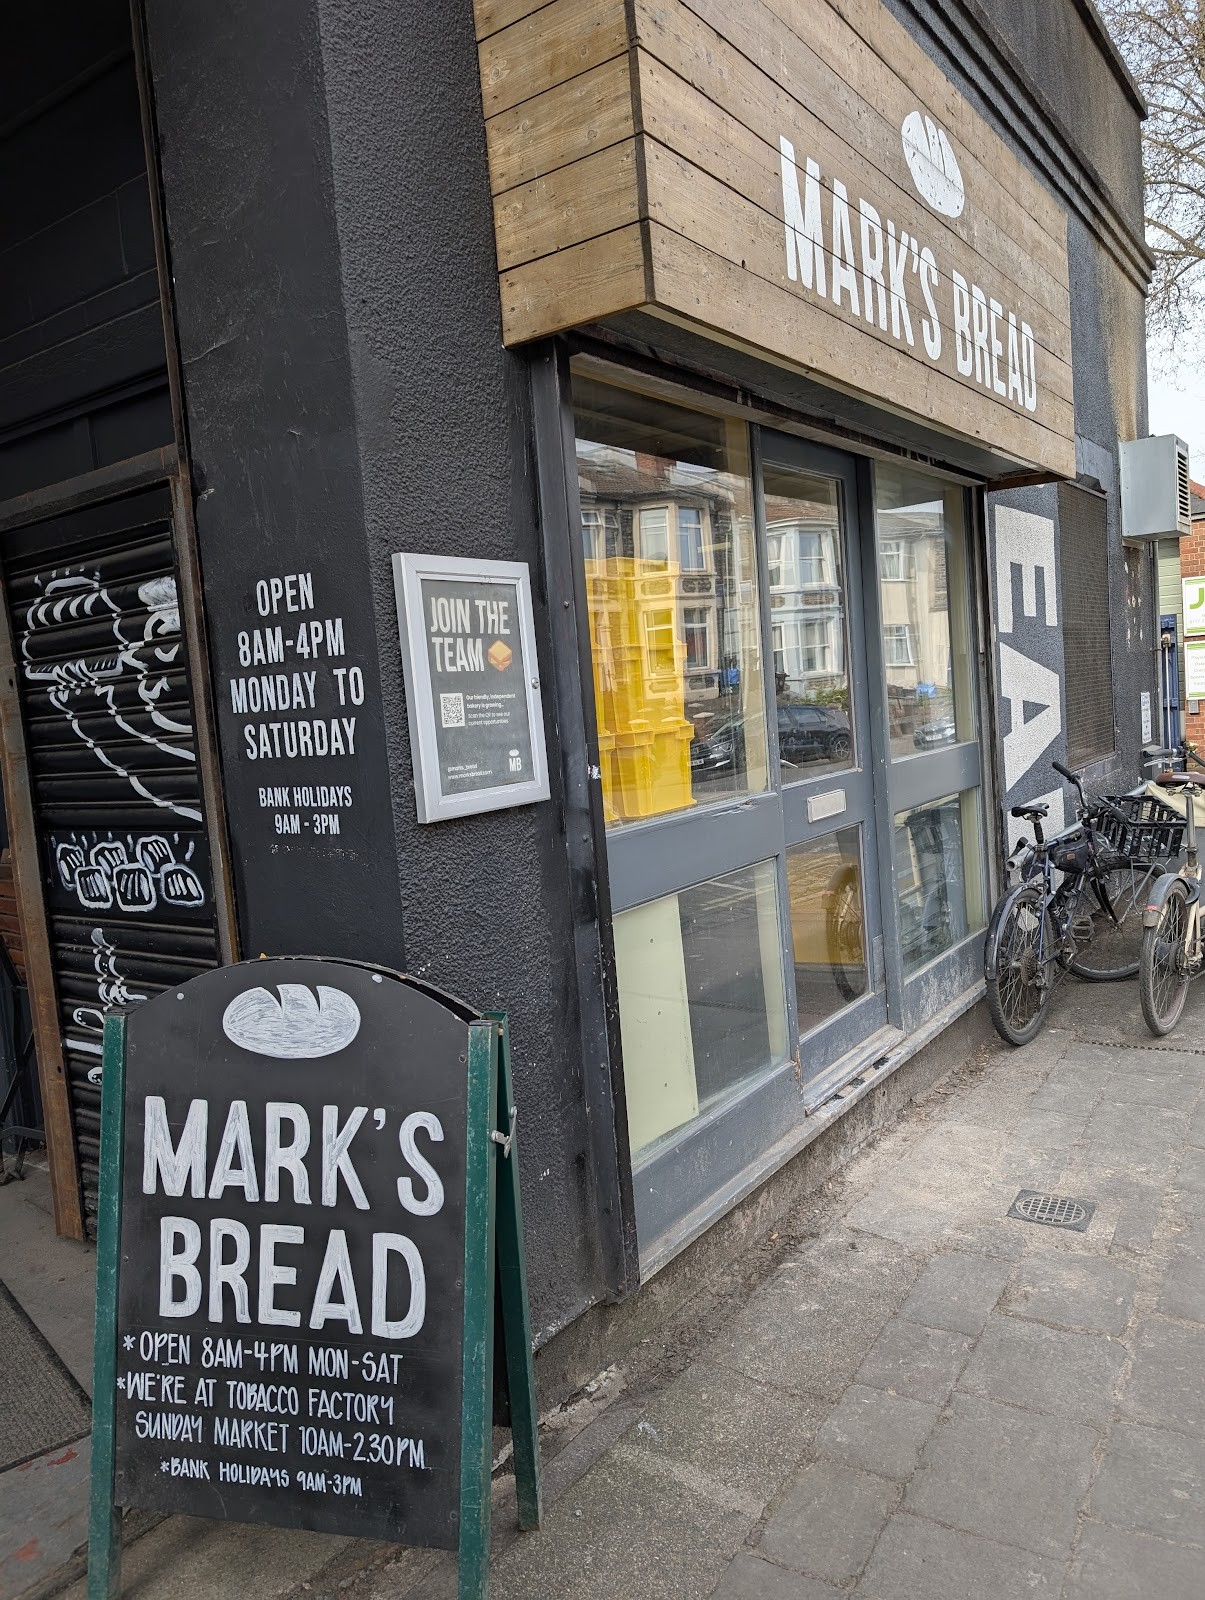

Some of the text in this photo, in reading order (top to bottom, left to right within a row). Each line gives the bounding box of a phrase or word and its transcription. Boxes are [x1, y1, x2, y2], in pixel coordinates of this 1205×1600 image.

[779, 135, 1037, 412] MARK'S BREAD
[256, 572, 315, 617] OPEN
[430, 597, 511, 635] JOIN THE
[237, 618, 346, 667] 8AM-4PM
[431, 637, 485, 673] TEAM
[230, 666, 364, 714] MONDAY TO
[244, 718, 356, 759] SATURDAY
[508, 757, 522, 772] MB
[259, 786, 353, 808] BANK HOLIDAYS
[275, 814, 301, 835] 9AM
[312, 813, 341, 835] 3PM
[142, 1095, 445, 1217] MARK'S
[158, 1216, 426, 1340] BREAD
[202, 1337, 299, 1375] 8AM-4PM
[308, 1346, 404, 1385] MON-SAT
[194, 1377, 218, 1408] AT
[226, 1380, 299, 1416] TOBACCO
[308, 1388, 394, 1426] FACTORY
[135, 1410, 426, 1470] SUNDAY MARKET 10AM-2.30PM
[219, 1461, 290, 1488] HOLIDAYS
[297, 1470, 363, 1498] 9AM-3PM
